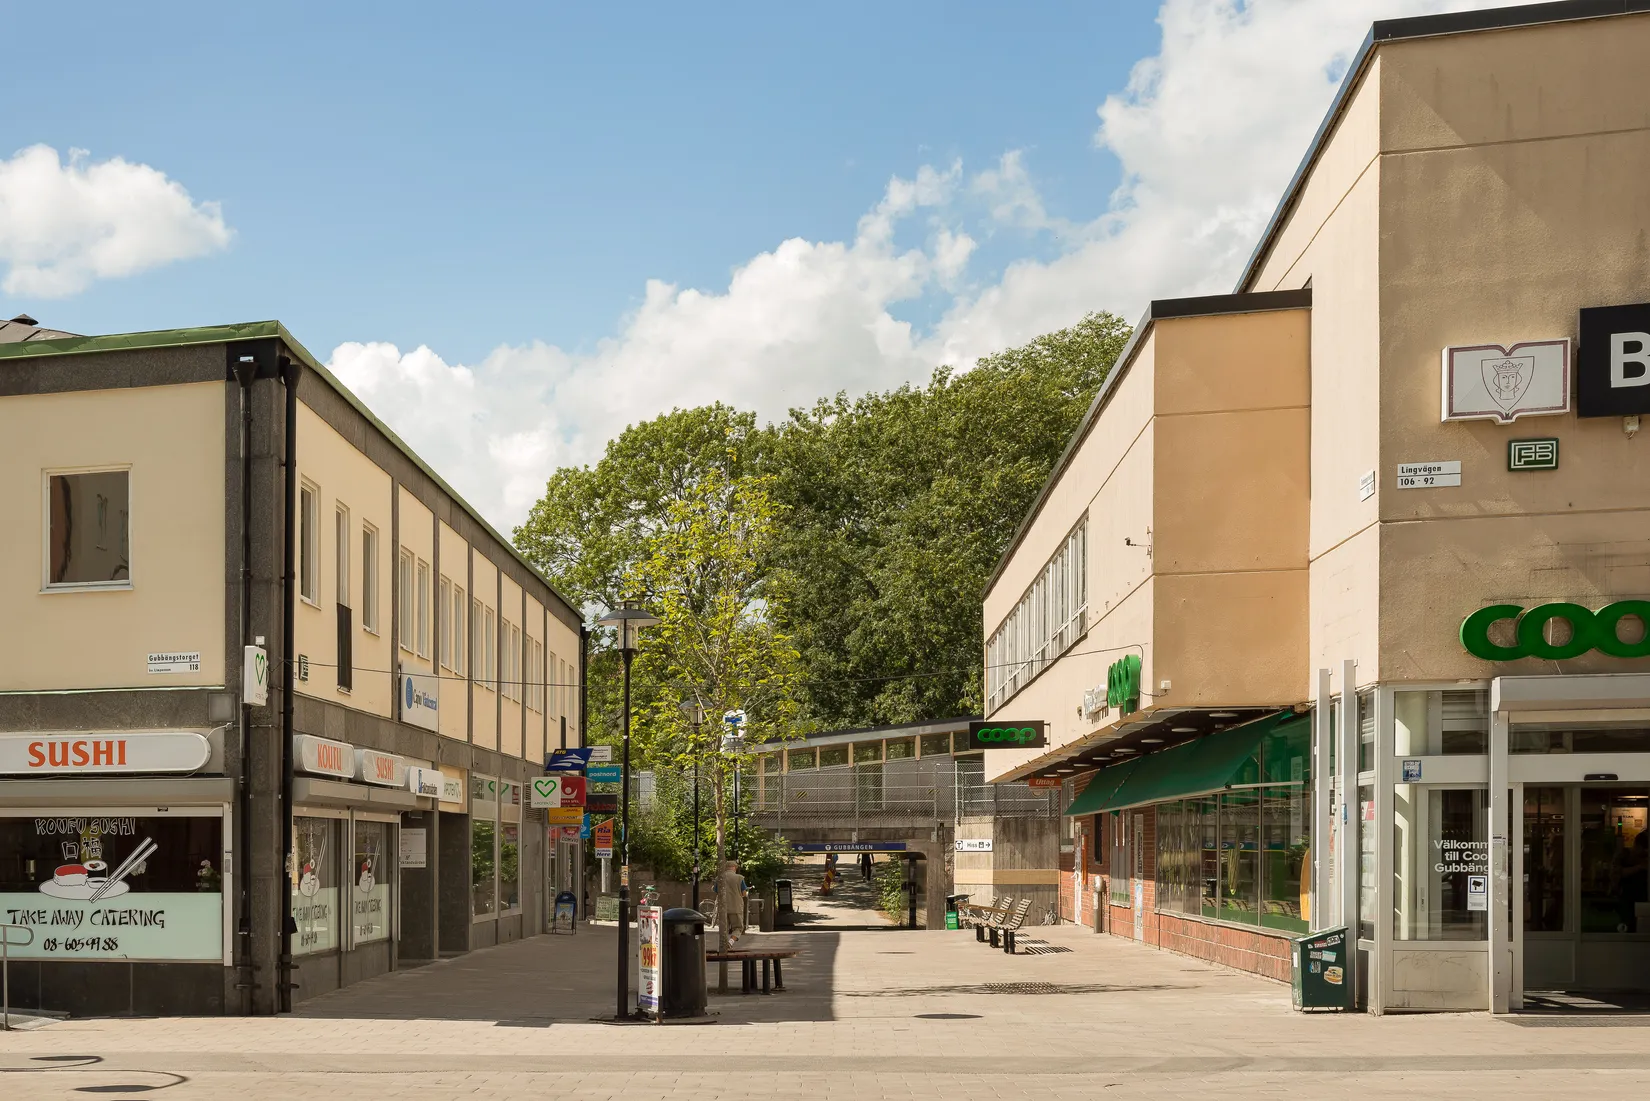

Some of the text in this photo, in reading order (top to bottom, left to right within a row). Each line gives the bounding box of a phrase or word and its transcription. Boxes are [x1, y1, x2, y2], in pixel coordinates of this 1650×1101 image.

[1610, 331, 1650, 388] B
[1401, 464, 1442, 475] Lingvägen
[1400, 478, 1415, 486] 106
[1424, 477, 1435, 485] 92
[148, 653, 199, 663] Gubbängstorget
[977, 727, 1037, 745] coop
[28, 740, 127, 767] SUSHI
[1035, 779, 1055, 787] Uttag
[35, 818, 136, 835] KOUFU SUSHI
[597, 826, 611, 834] Ria
[1445, 851, 1459, 861] till
[7, 909, 165, 931] TAKE AWAY CATERING
